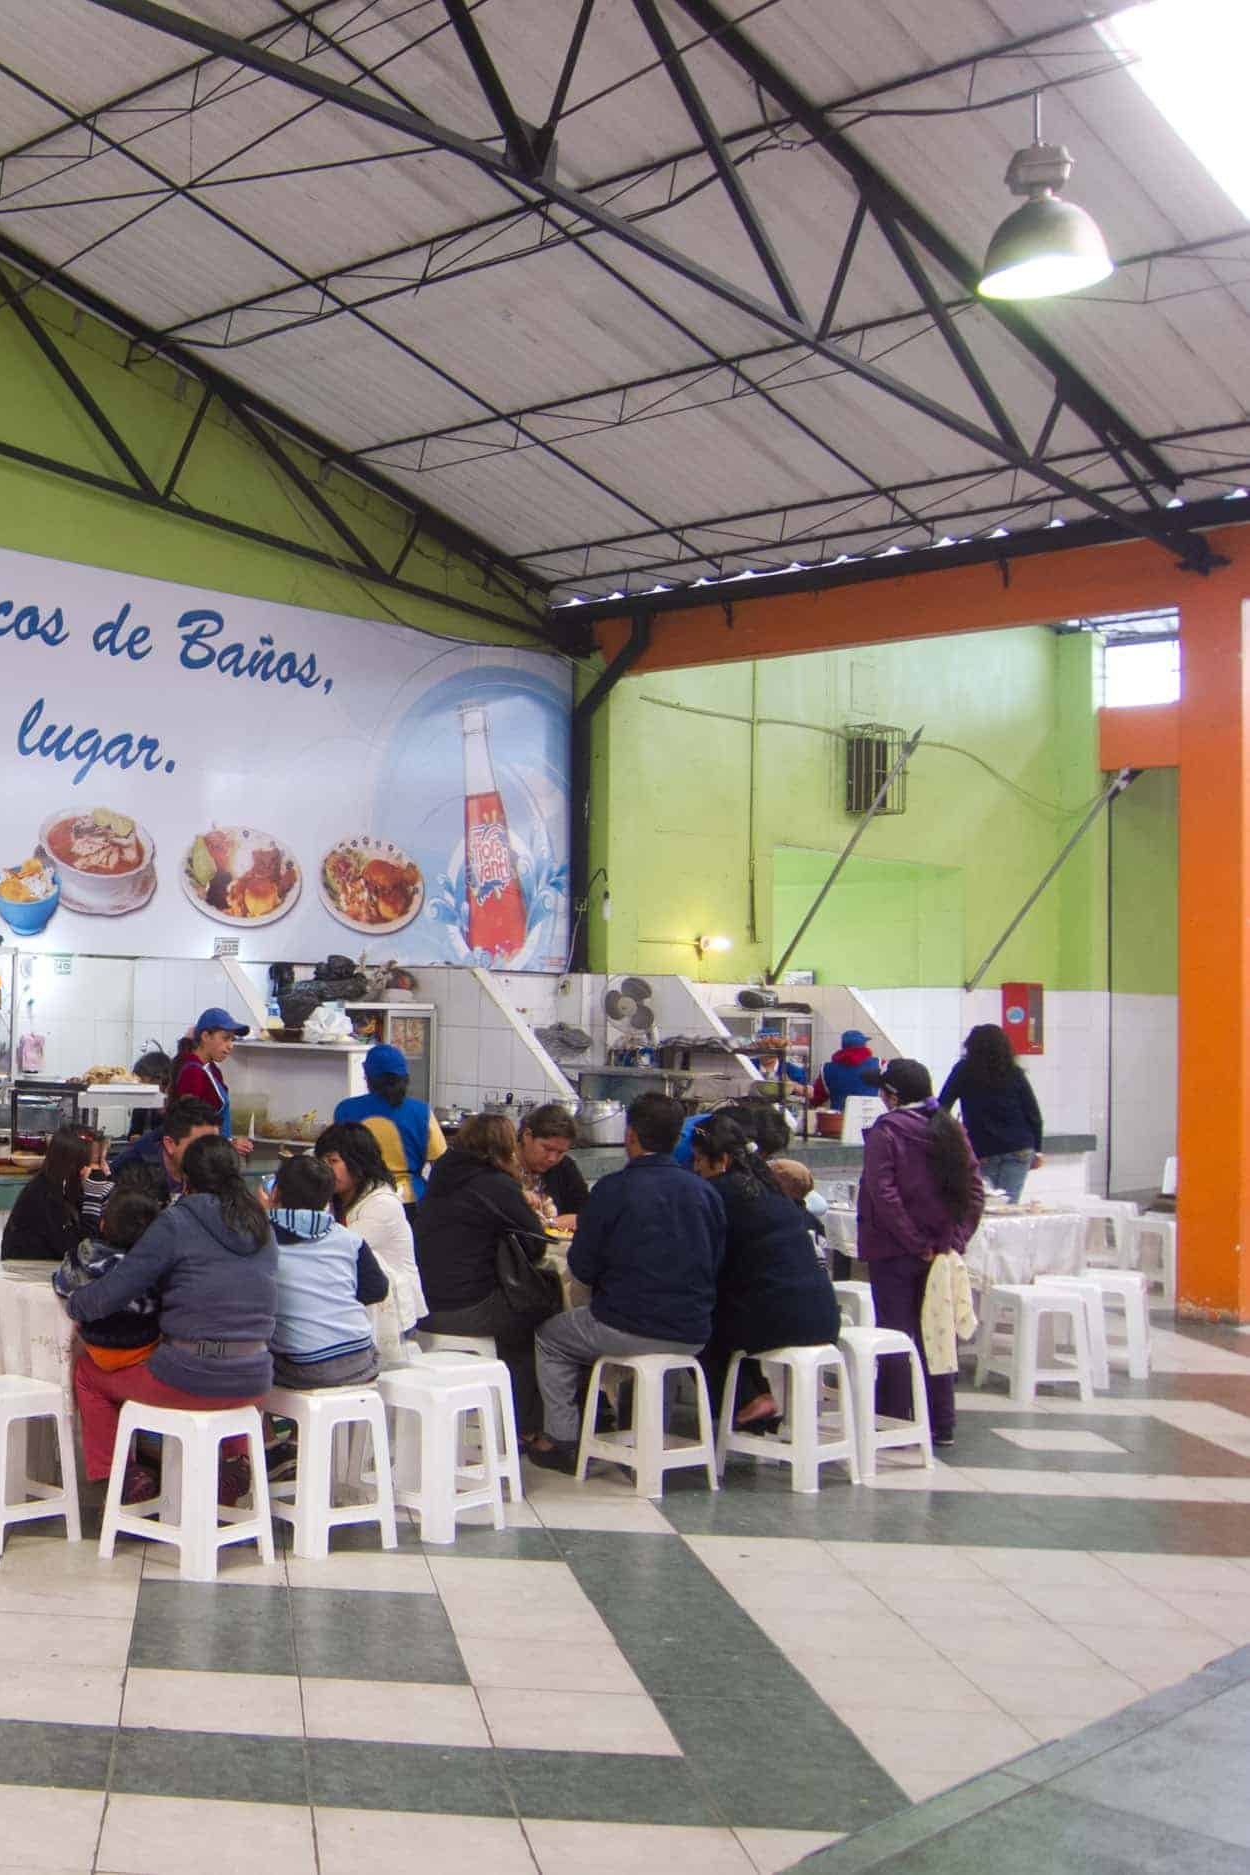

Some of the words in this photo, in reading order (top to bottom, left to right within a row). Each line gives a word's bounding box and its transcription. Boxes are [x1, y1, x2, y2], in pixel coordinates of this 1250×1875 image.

[93, 603, 151, 660] de
[177, 610, 333, 694] Baños,
[18, 698, 175, 785] lugar.
